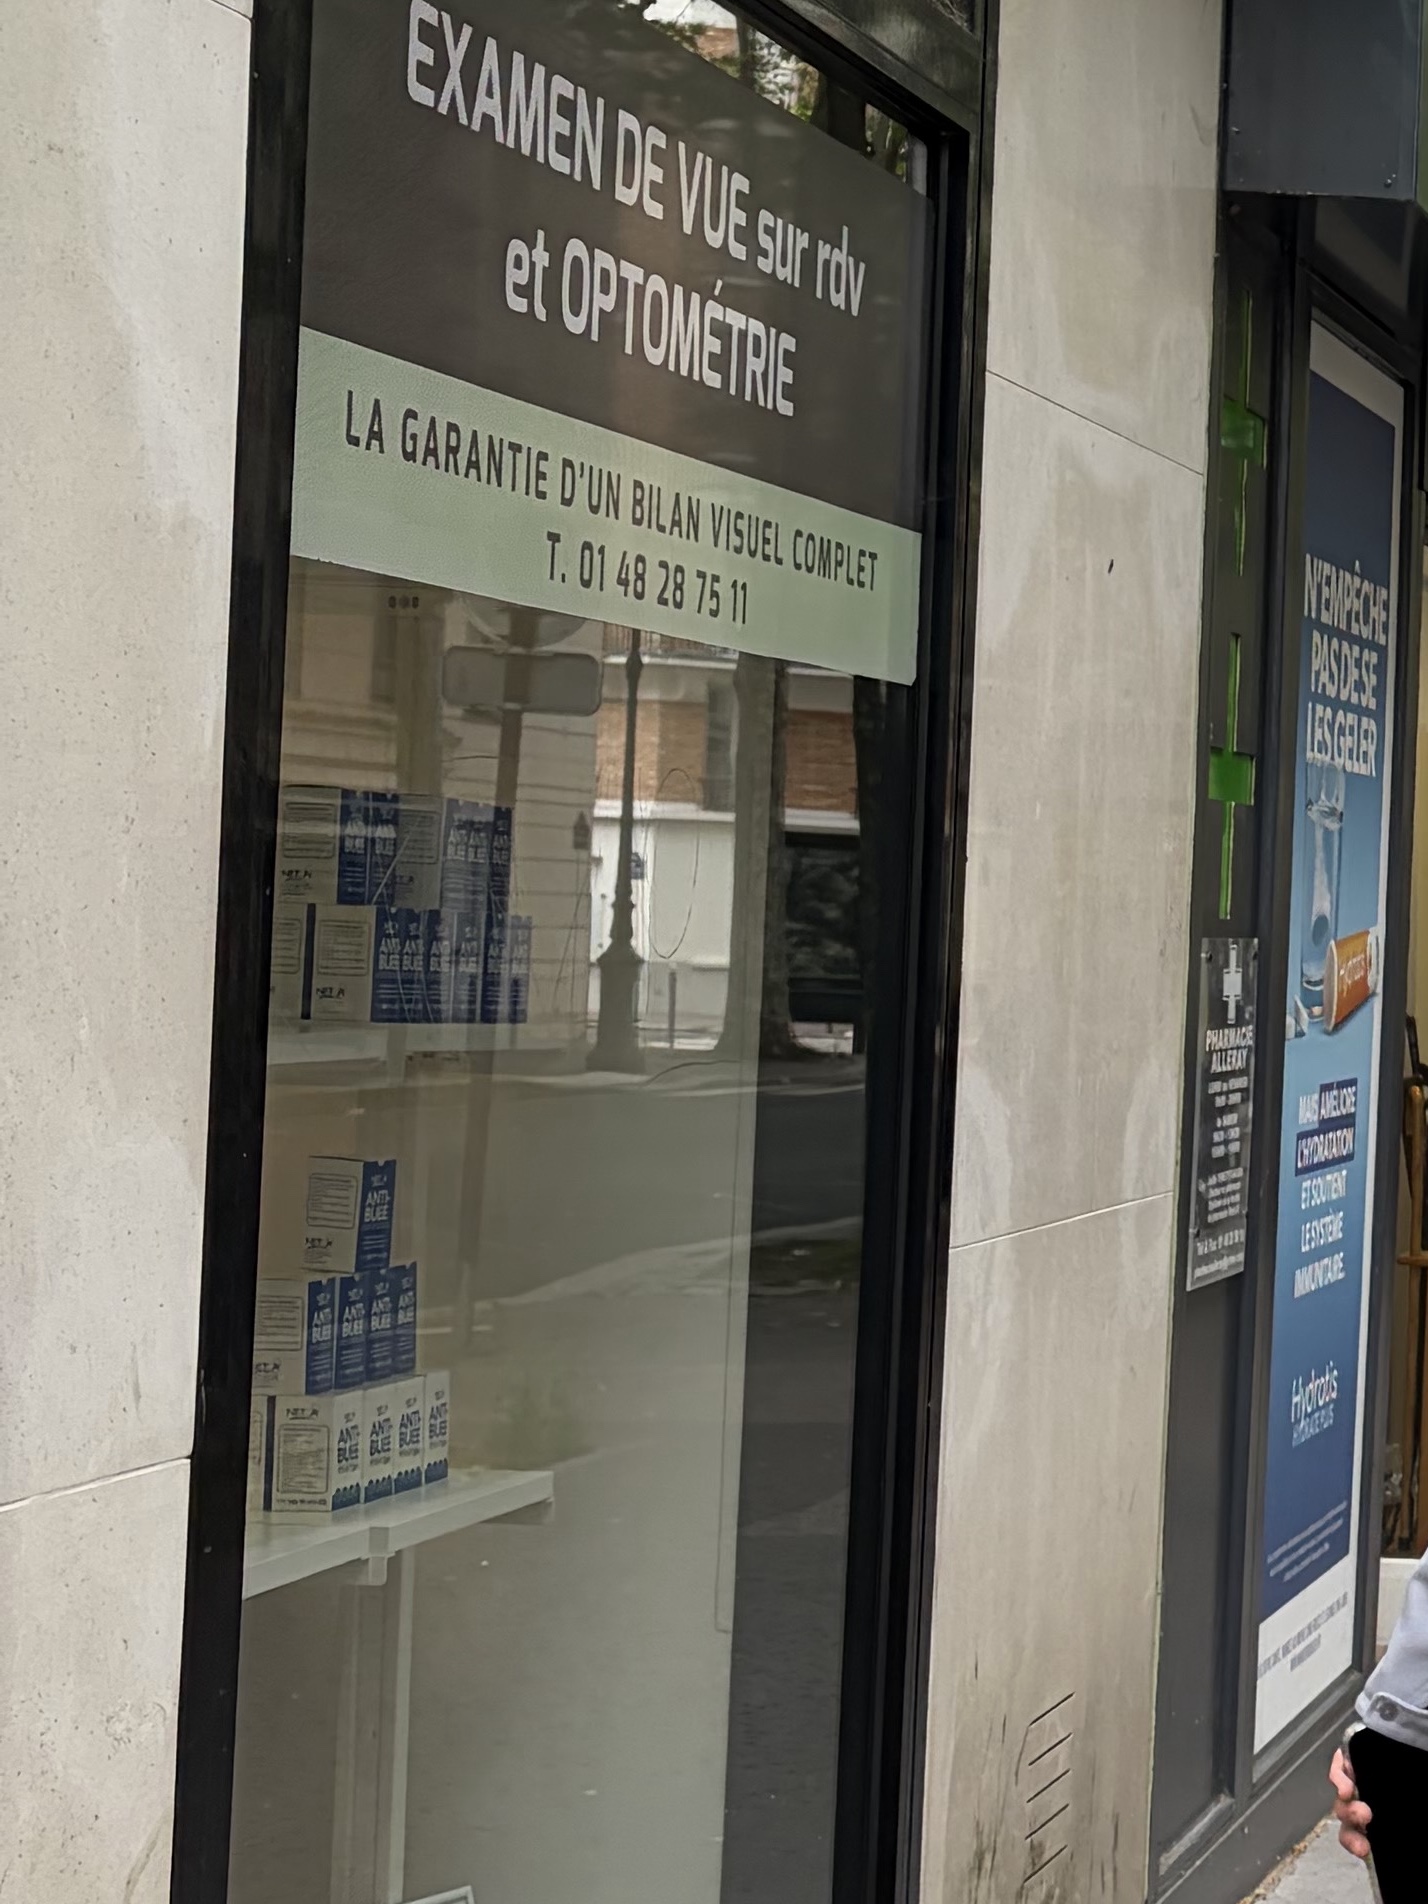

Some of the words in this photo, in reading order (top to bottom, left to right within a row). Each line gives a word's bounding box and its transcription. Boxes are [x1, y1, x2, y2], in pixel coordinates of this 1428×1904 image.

[614, 108, 668, 220] DE
[678, 140, 750, 262] VUE
[756, 208, 810, 289] sur
[814, 225, 867, 318] rdv
[504, 228, 551, 323] et
[561, 236, 797, 418] OPTOMÉTRIE
[344, 389, 386, 455] LA
[400, 407, 550, 501] GARANTIE
[559, 457, 621, 521] D'UN
[631, 479, 701, 544] BILAN
[710, 501, 784, 567] VISUEL
[791, 528, 879, 592] COMPLET
[545, 530, 567, 585] T.
[578, 540, 606, 593] 01
[615, 549, 647, 601] 48
[657, 560, 685, 610] 28
[695, 569, 721, 619] 75
[730, 577, 749, 625] 11
[1303, 552, 1389, 646] N'EMPÊCHE
[1311, 628, 1340, 700] PAS
[1340, 640, 1360, 706] DE
[1360, 647, 1379, 711] SE
[1305, 700, 1333, 767] LES
[1333, 708, 1377, 778] GELER
[1206, 1024, 1254, 1052] PHARMACIE
[1210, 1047, 1249, 1075] ALLERAY
[1298, 1091, 1319, 1125] MAIS
[1319, 1081, 1357, 1122] AMÉLIORE
[1297, 1126, 1355, 1169] L'HYDRATATION
[1301, 1222, 1311, 1253] LE
